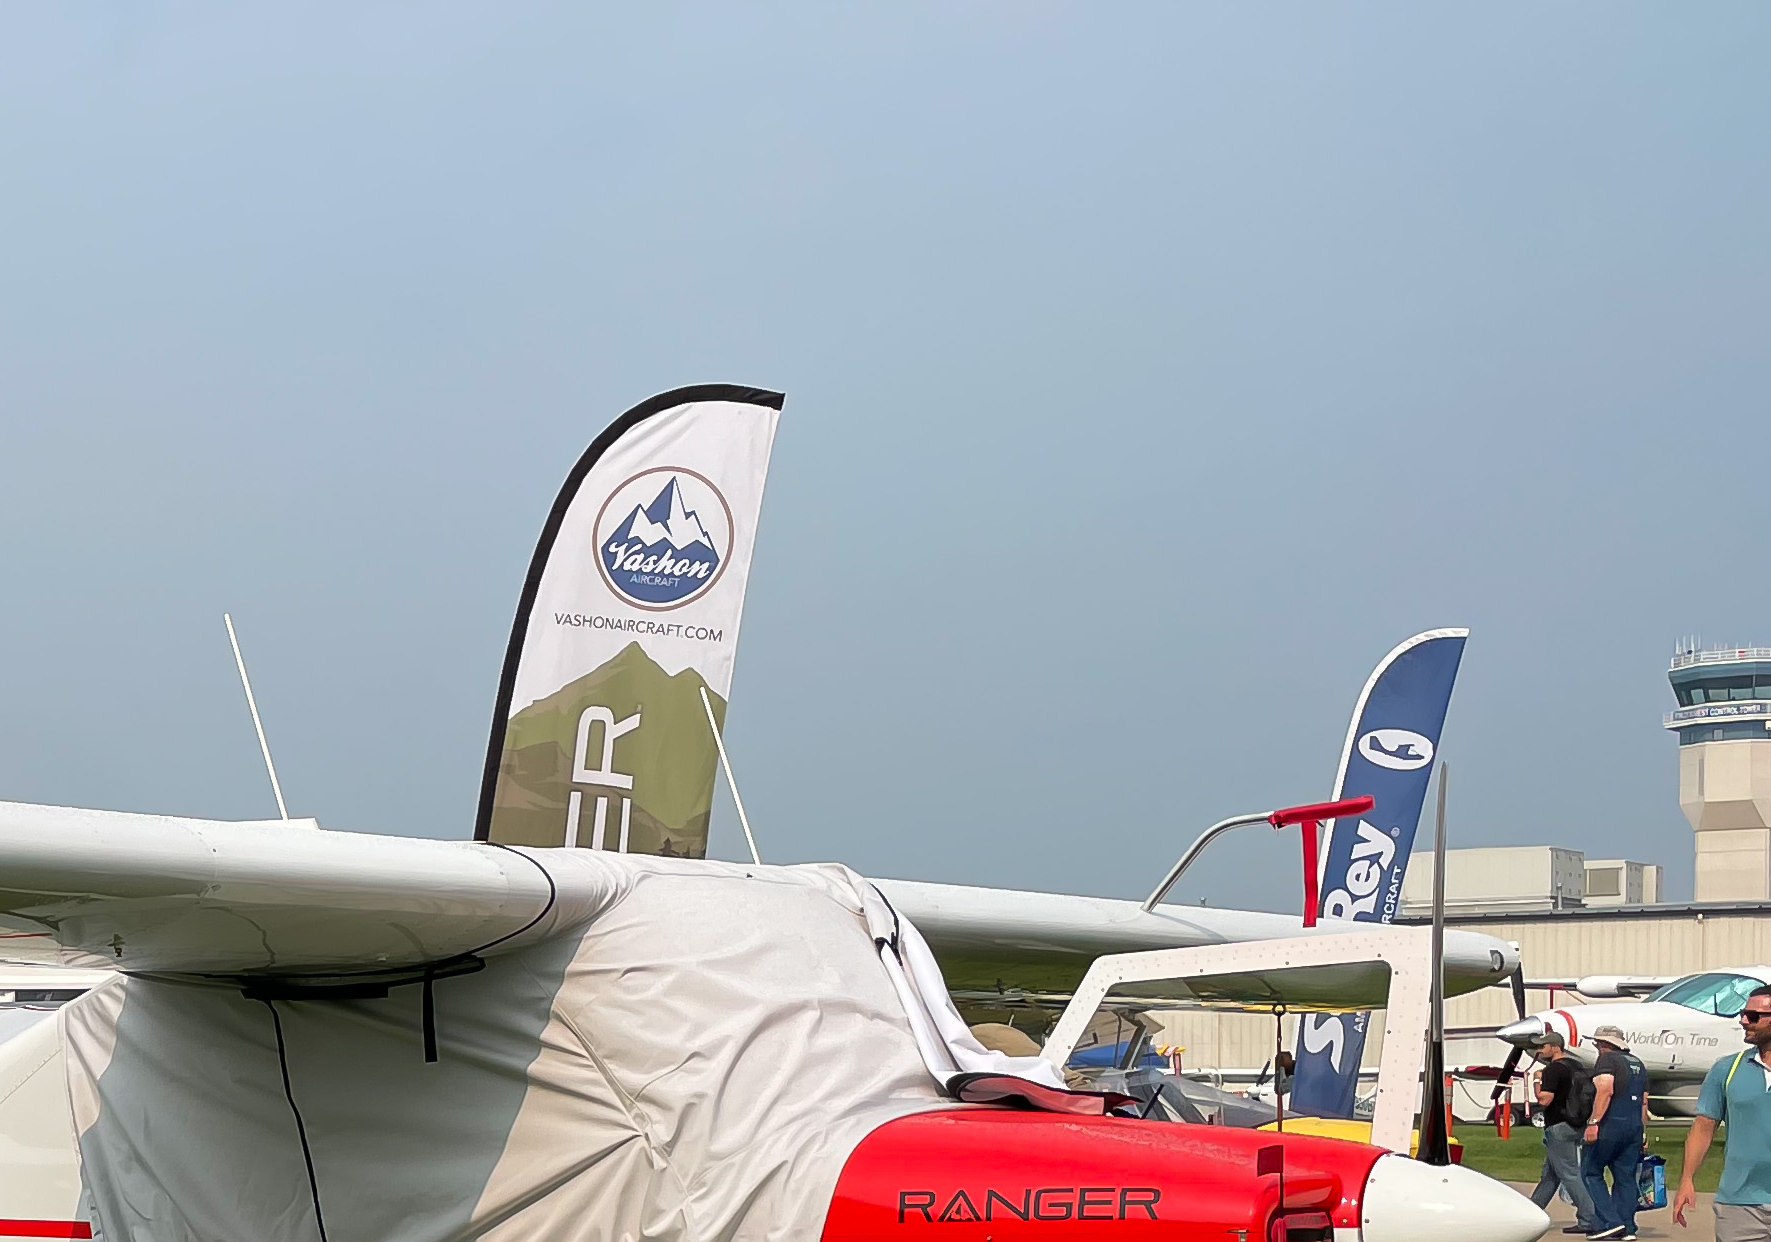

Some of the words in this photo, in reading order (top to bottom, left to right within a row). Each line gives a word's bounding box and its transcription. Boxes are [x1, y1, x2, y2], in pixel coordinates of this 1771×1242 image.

[609, 541, 711, 579] Vashon
[630, 573, 680, 588] AIRCRAFT
[554, 612, 723, 642] VASHONAIRCRAFT.COM
[1664, 1032, 1684, 1046] On
[1689, 1032, 1719, 1047] Time
[897, 1187, 1162, 1224] RANGER
